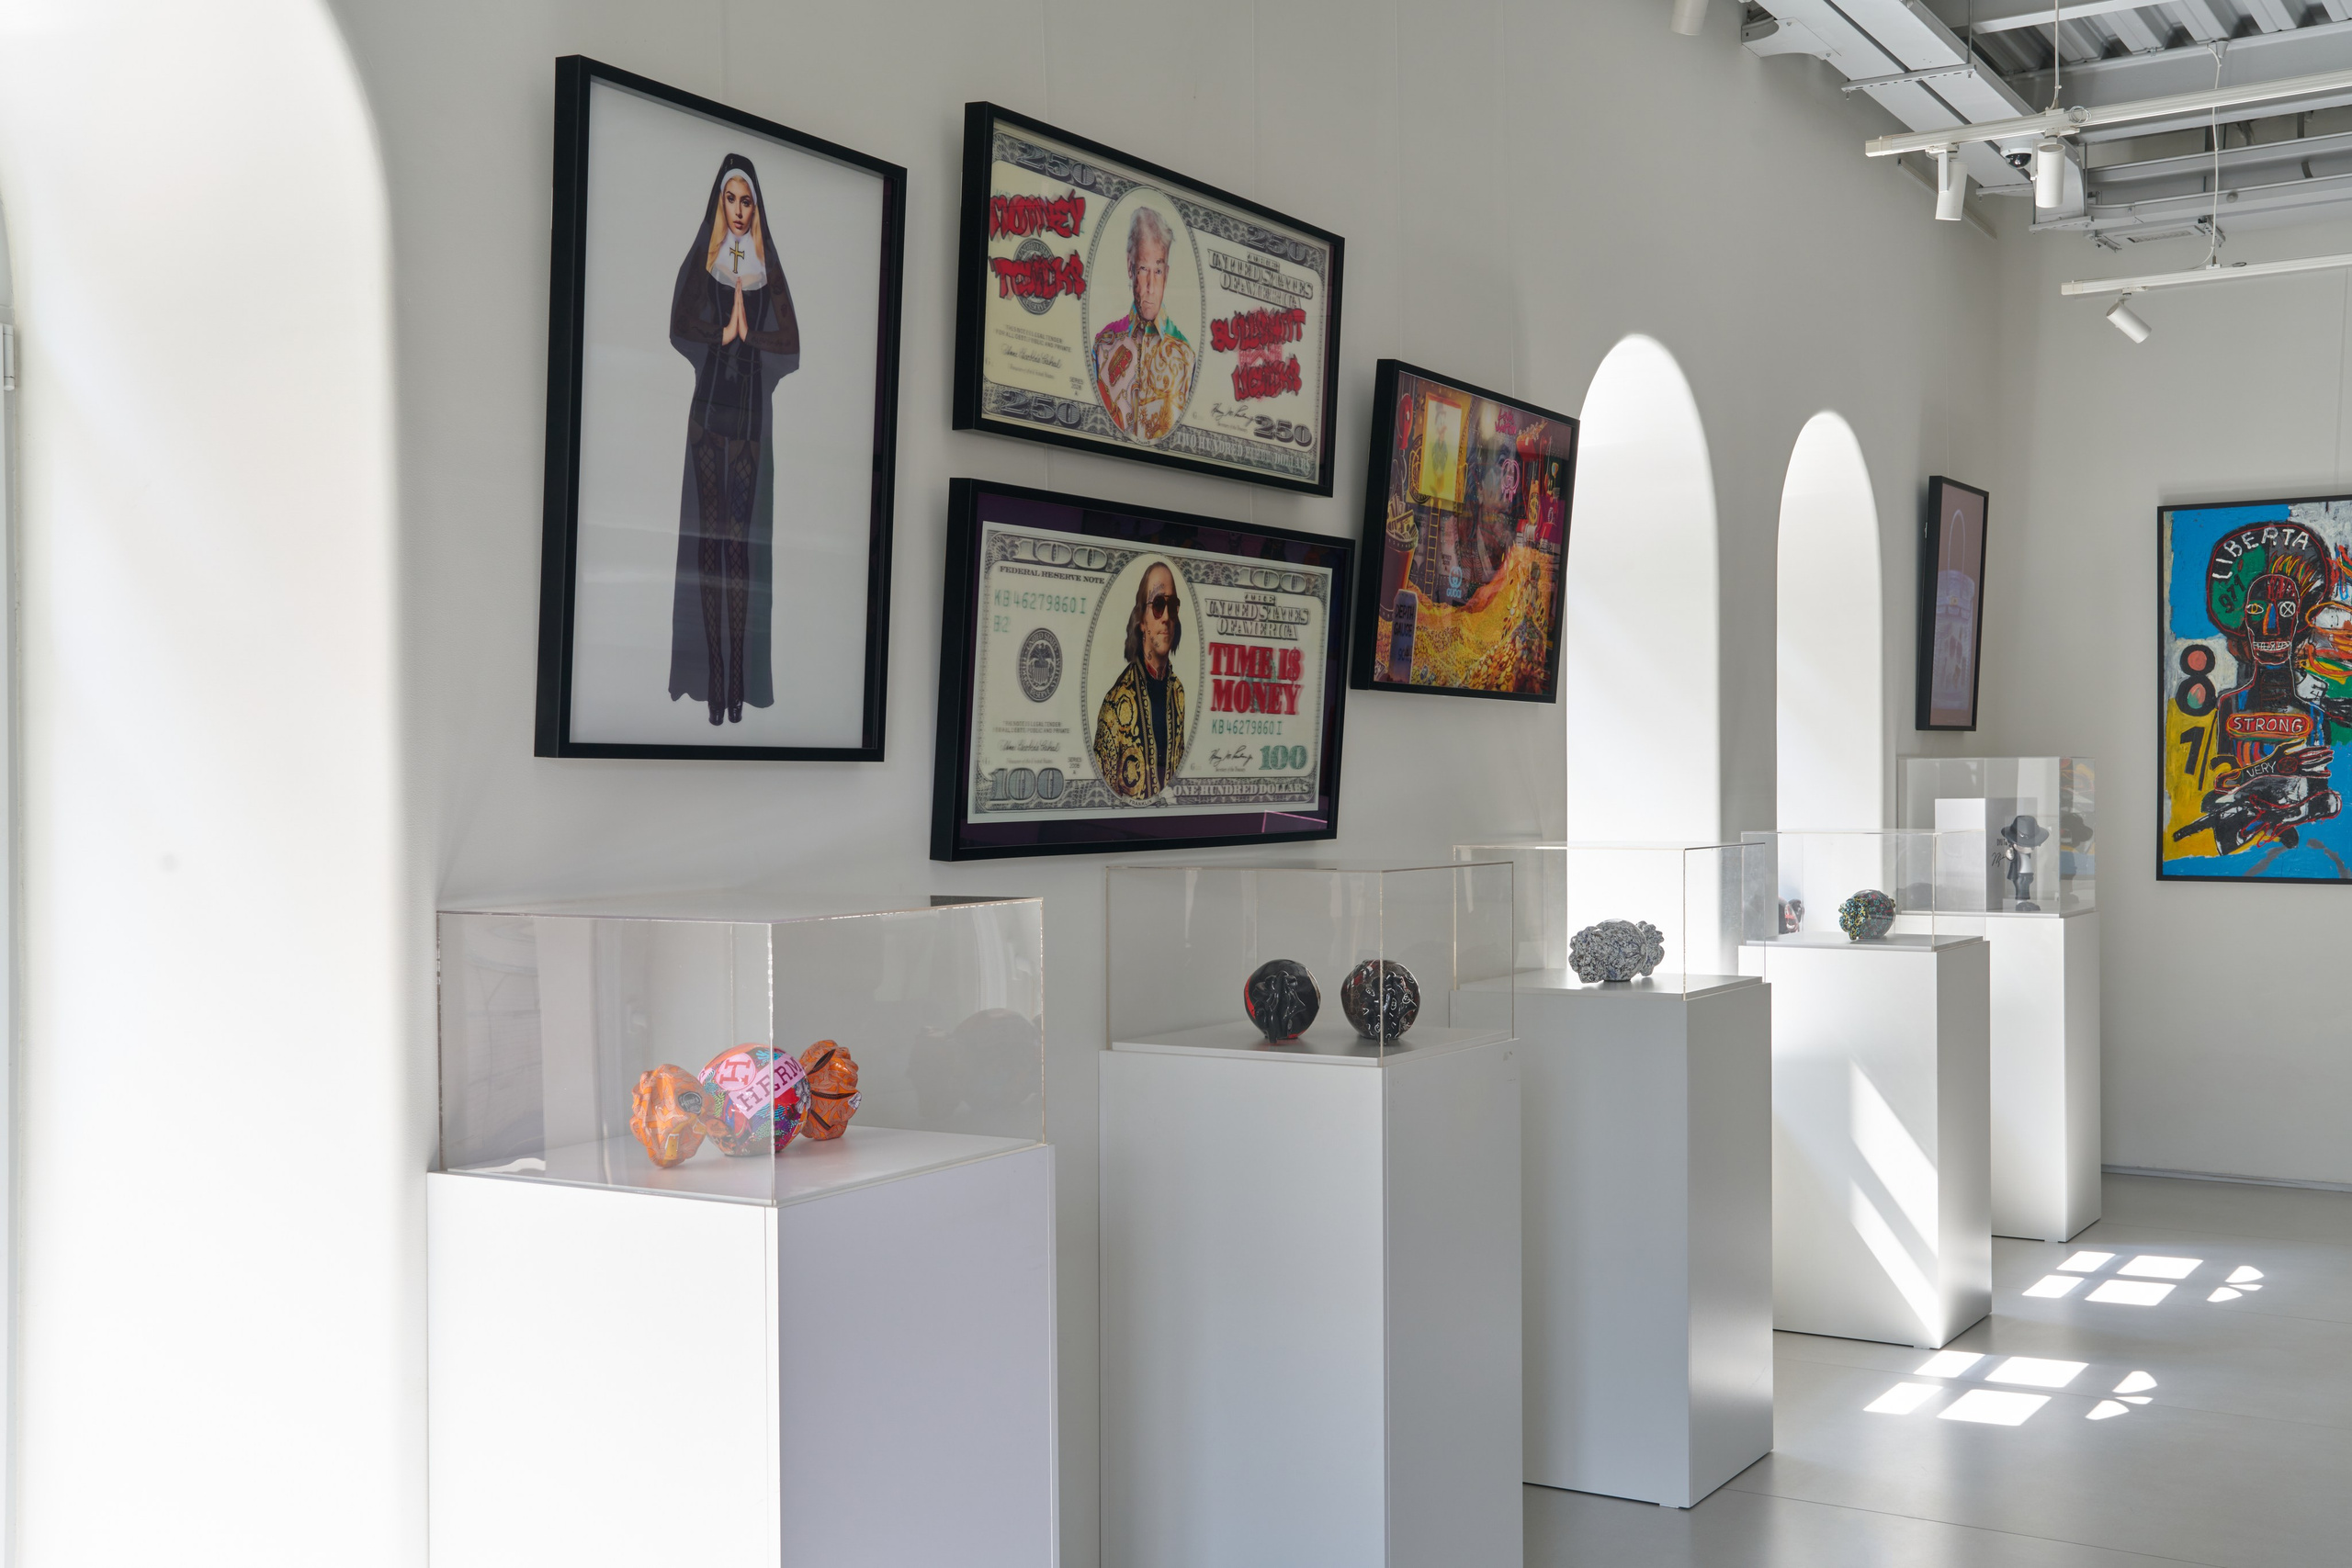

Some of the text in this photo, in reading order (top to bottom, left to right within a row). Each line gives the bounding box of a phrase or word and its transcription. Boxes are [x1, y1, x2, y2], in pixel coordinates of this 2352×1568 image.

[1016, 141, 1097, 190] 250
[1247, 225, 1306, 265] 250
[1207, 248, 1314, 299] UNITED STATES
[1001, 390, 1082, 429] 250
[1176, 431, 1197, 448] TWO
[1198, 435, 1244, 457] HUNDRED
[1253, 414, 1313, 447] 250
[1011, 538, 1109, 570] 100
[2211, 526, 2310, 580] LIBERTA
[1000, 565, 1105, 585] FEDERAL RESERVE NOTE
[1234, 568, 1307, 593] 100
[2218, 573, 2246, 614] 911
[1204, 598, 1309, 625] UNITED STATES
[1395, 604, 1415, 620] DEPTH
[1235, 620, 1298, 641] AMERICA
[1208, 642, 1273, 679] TIME
[1210, 679, 1302, 716] MONEY
[2233, 716, 2304, 734] STRONG
[1258, 744, 1309, 771] 100
[2245, 761, 2277, 778] VERY
[989, 767, 1065, 802] 100
[1173, 783, 1310, 796] ONE HUNDRED DOLLARS
